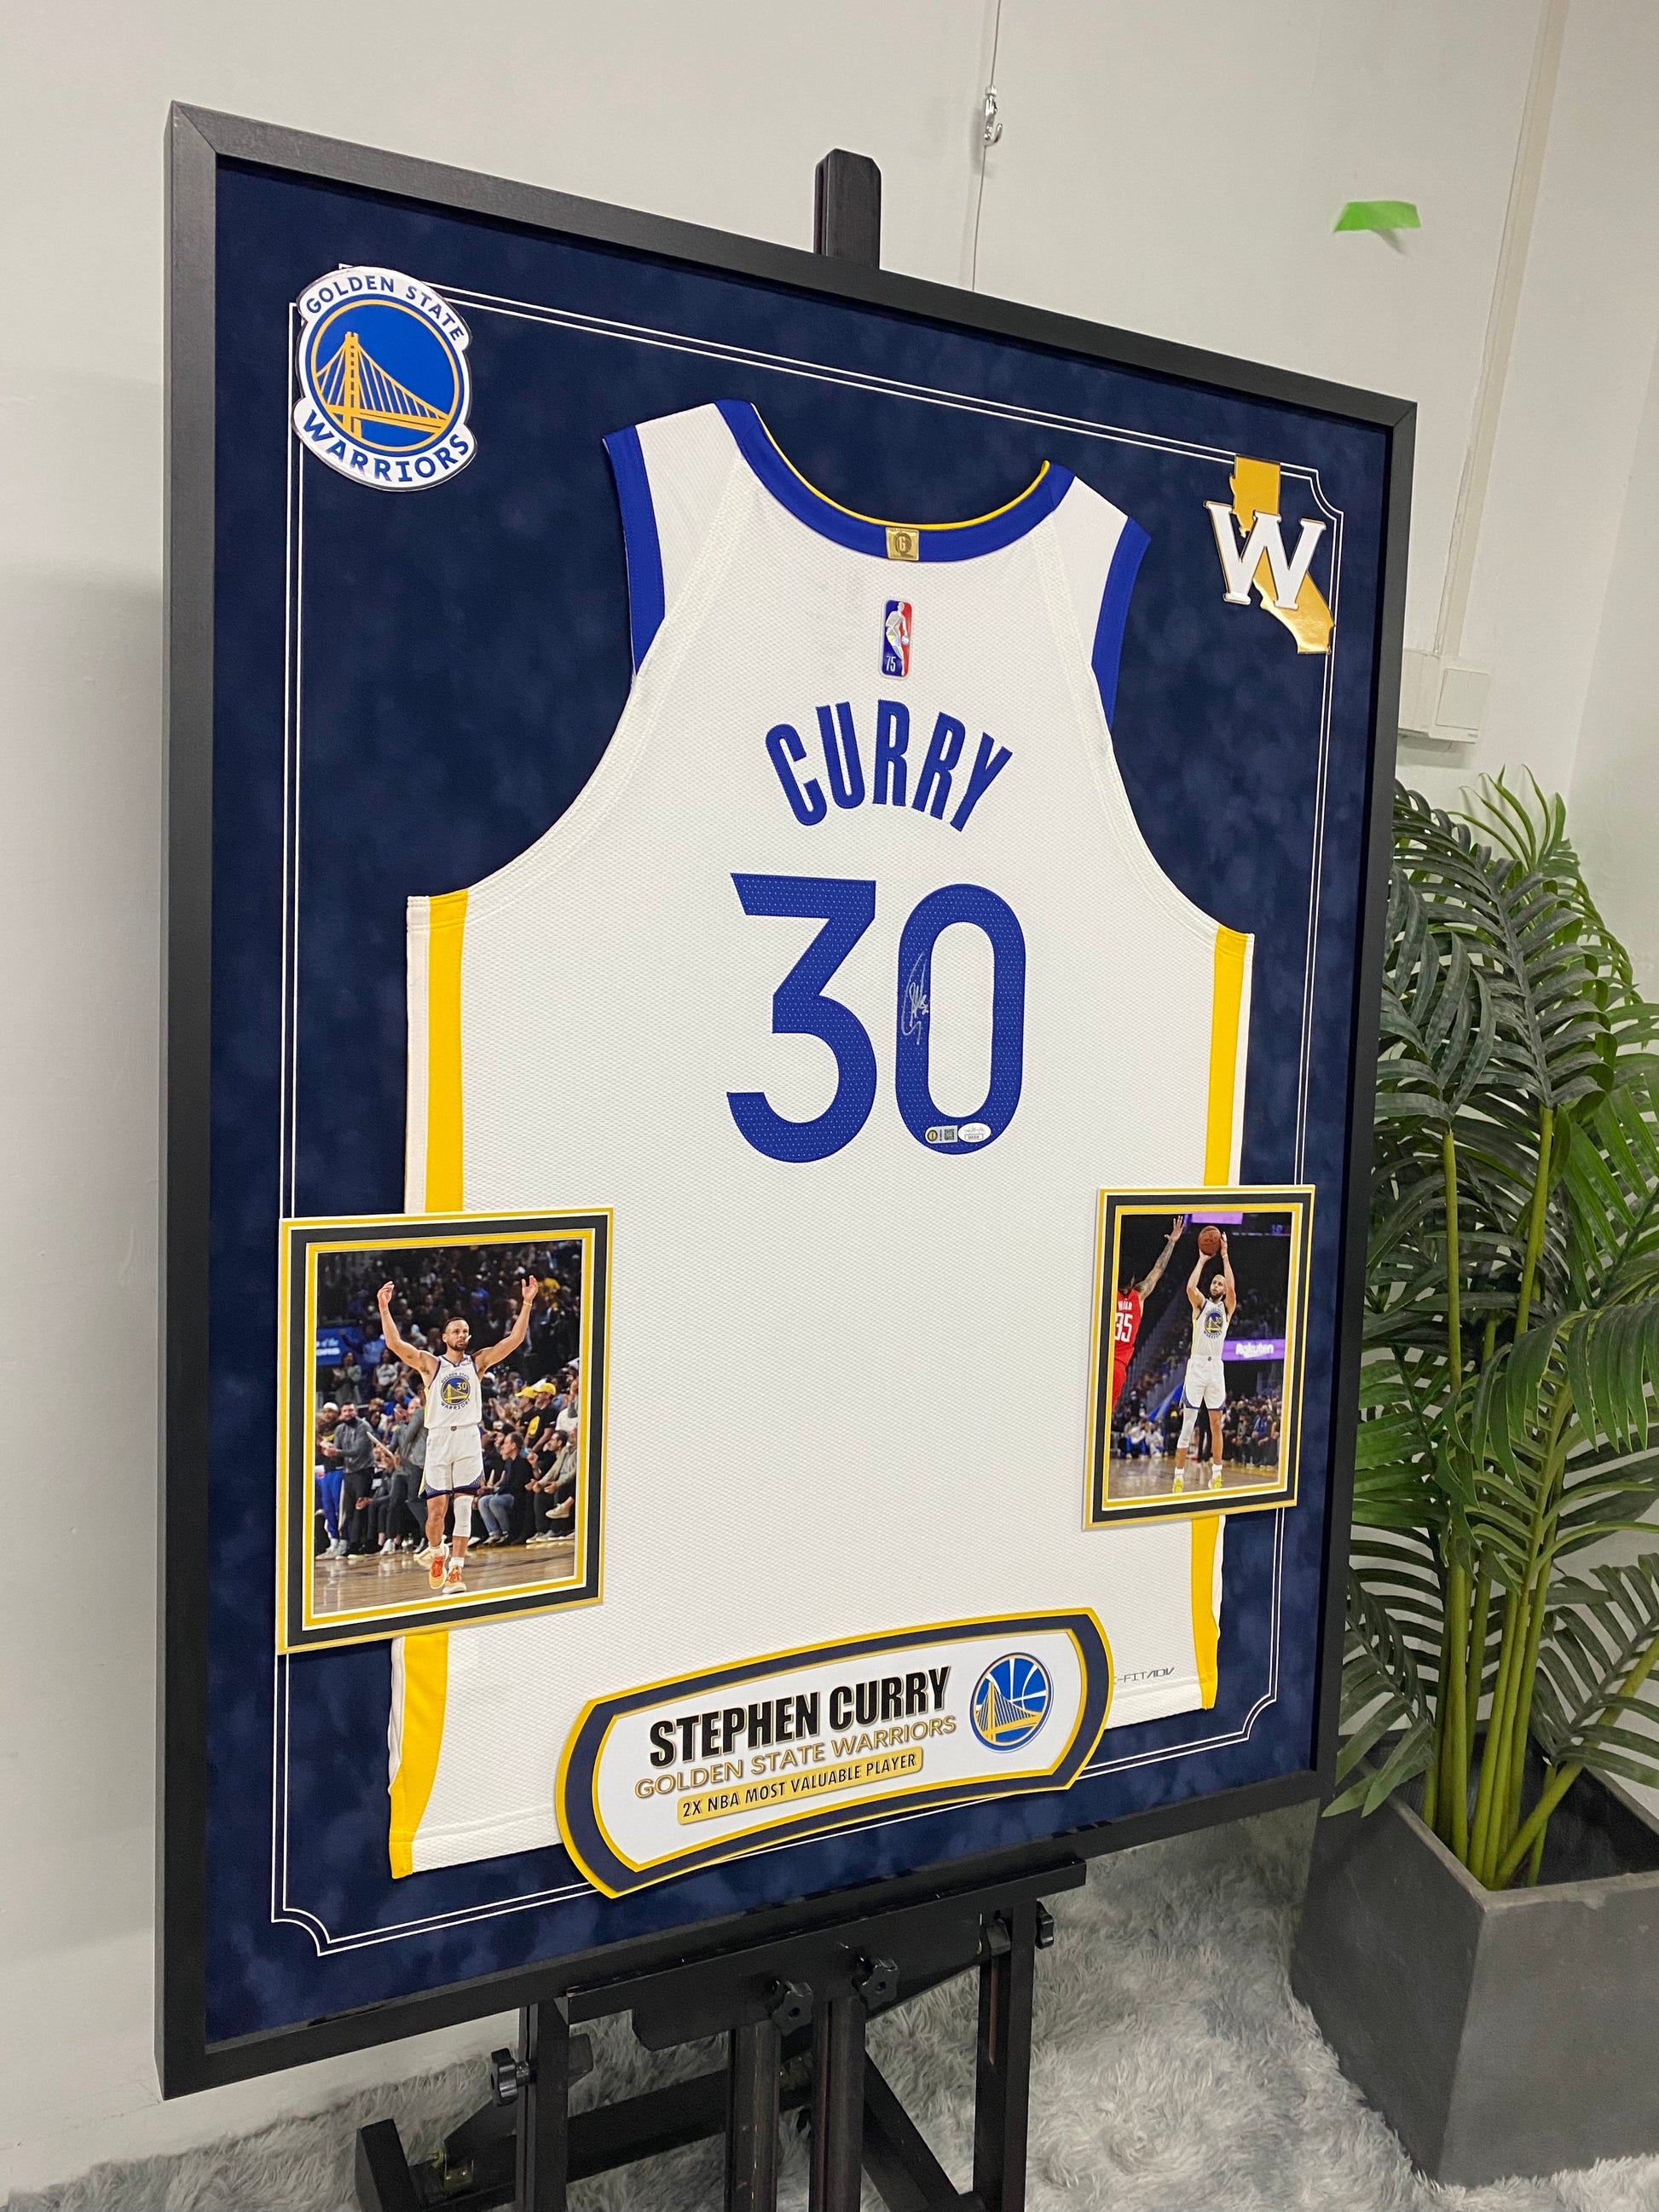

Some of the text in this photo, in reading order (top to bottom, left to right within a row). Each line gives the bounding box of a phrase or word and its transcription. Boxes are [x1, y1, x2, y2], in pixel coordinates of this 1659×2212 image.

[306, 275, 465, 341] GOLDEN STATE
[303, 409, 469, 482] WARRIORS
[1203, 500, 1327, 610] W
[885, 655, 897, 672] 75
[766, 699, 1013, 832] CURRY
[726, 873, 1026, 1163] 30
[456, 1382, 467, 1391] 30
[650, 1666, 951, 1768] STEPHEN CURRY
[635, 1715, 956, 1799] GOLDEN STATE WARRIORS
[683, 1753, 916, 1817] 2X NBA MOST VALUABLE PLAYER
